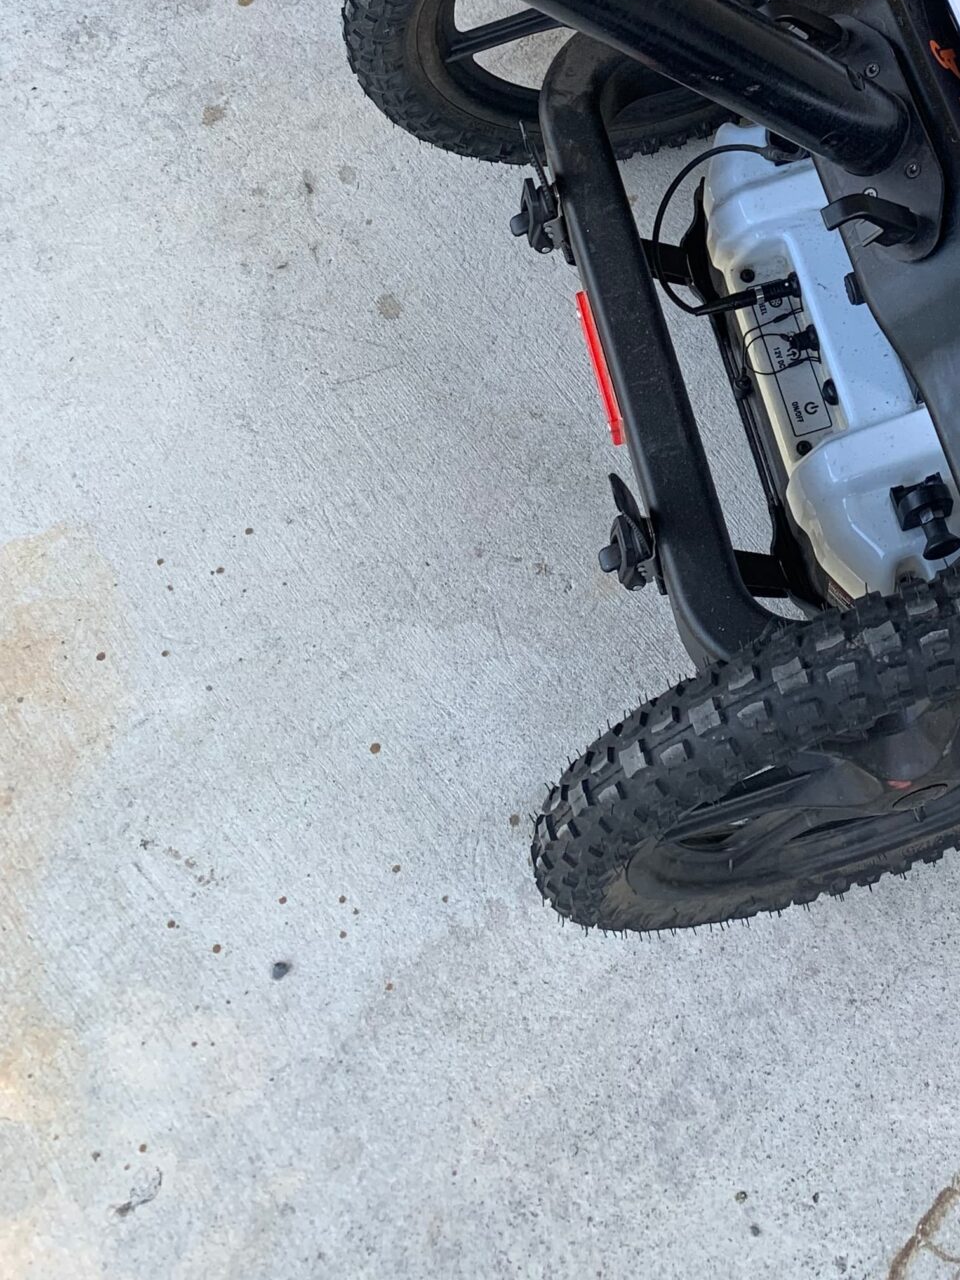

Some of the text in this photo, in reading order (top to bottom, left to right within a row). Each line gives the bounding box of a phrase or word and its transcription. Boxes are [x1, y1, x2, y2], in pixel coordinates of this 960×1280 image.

[773, 346, 786, 369] 12V DC
[791, 401, 804, 423] ON/OFF
